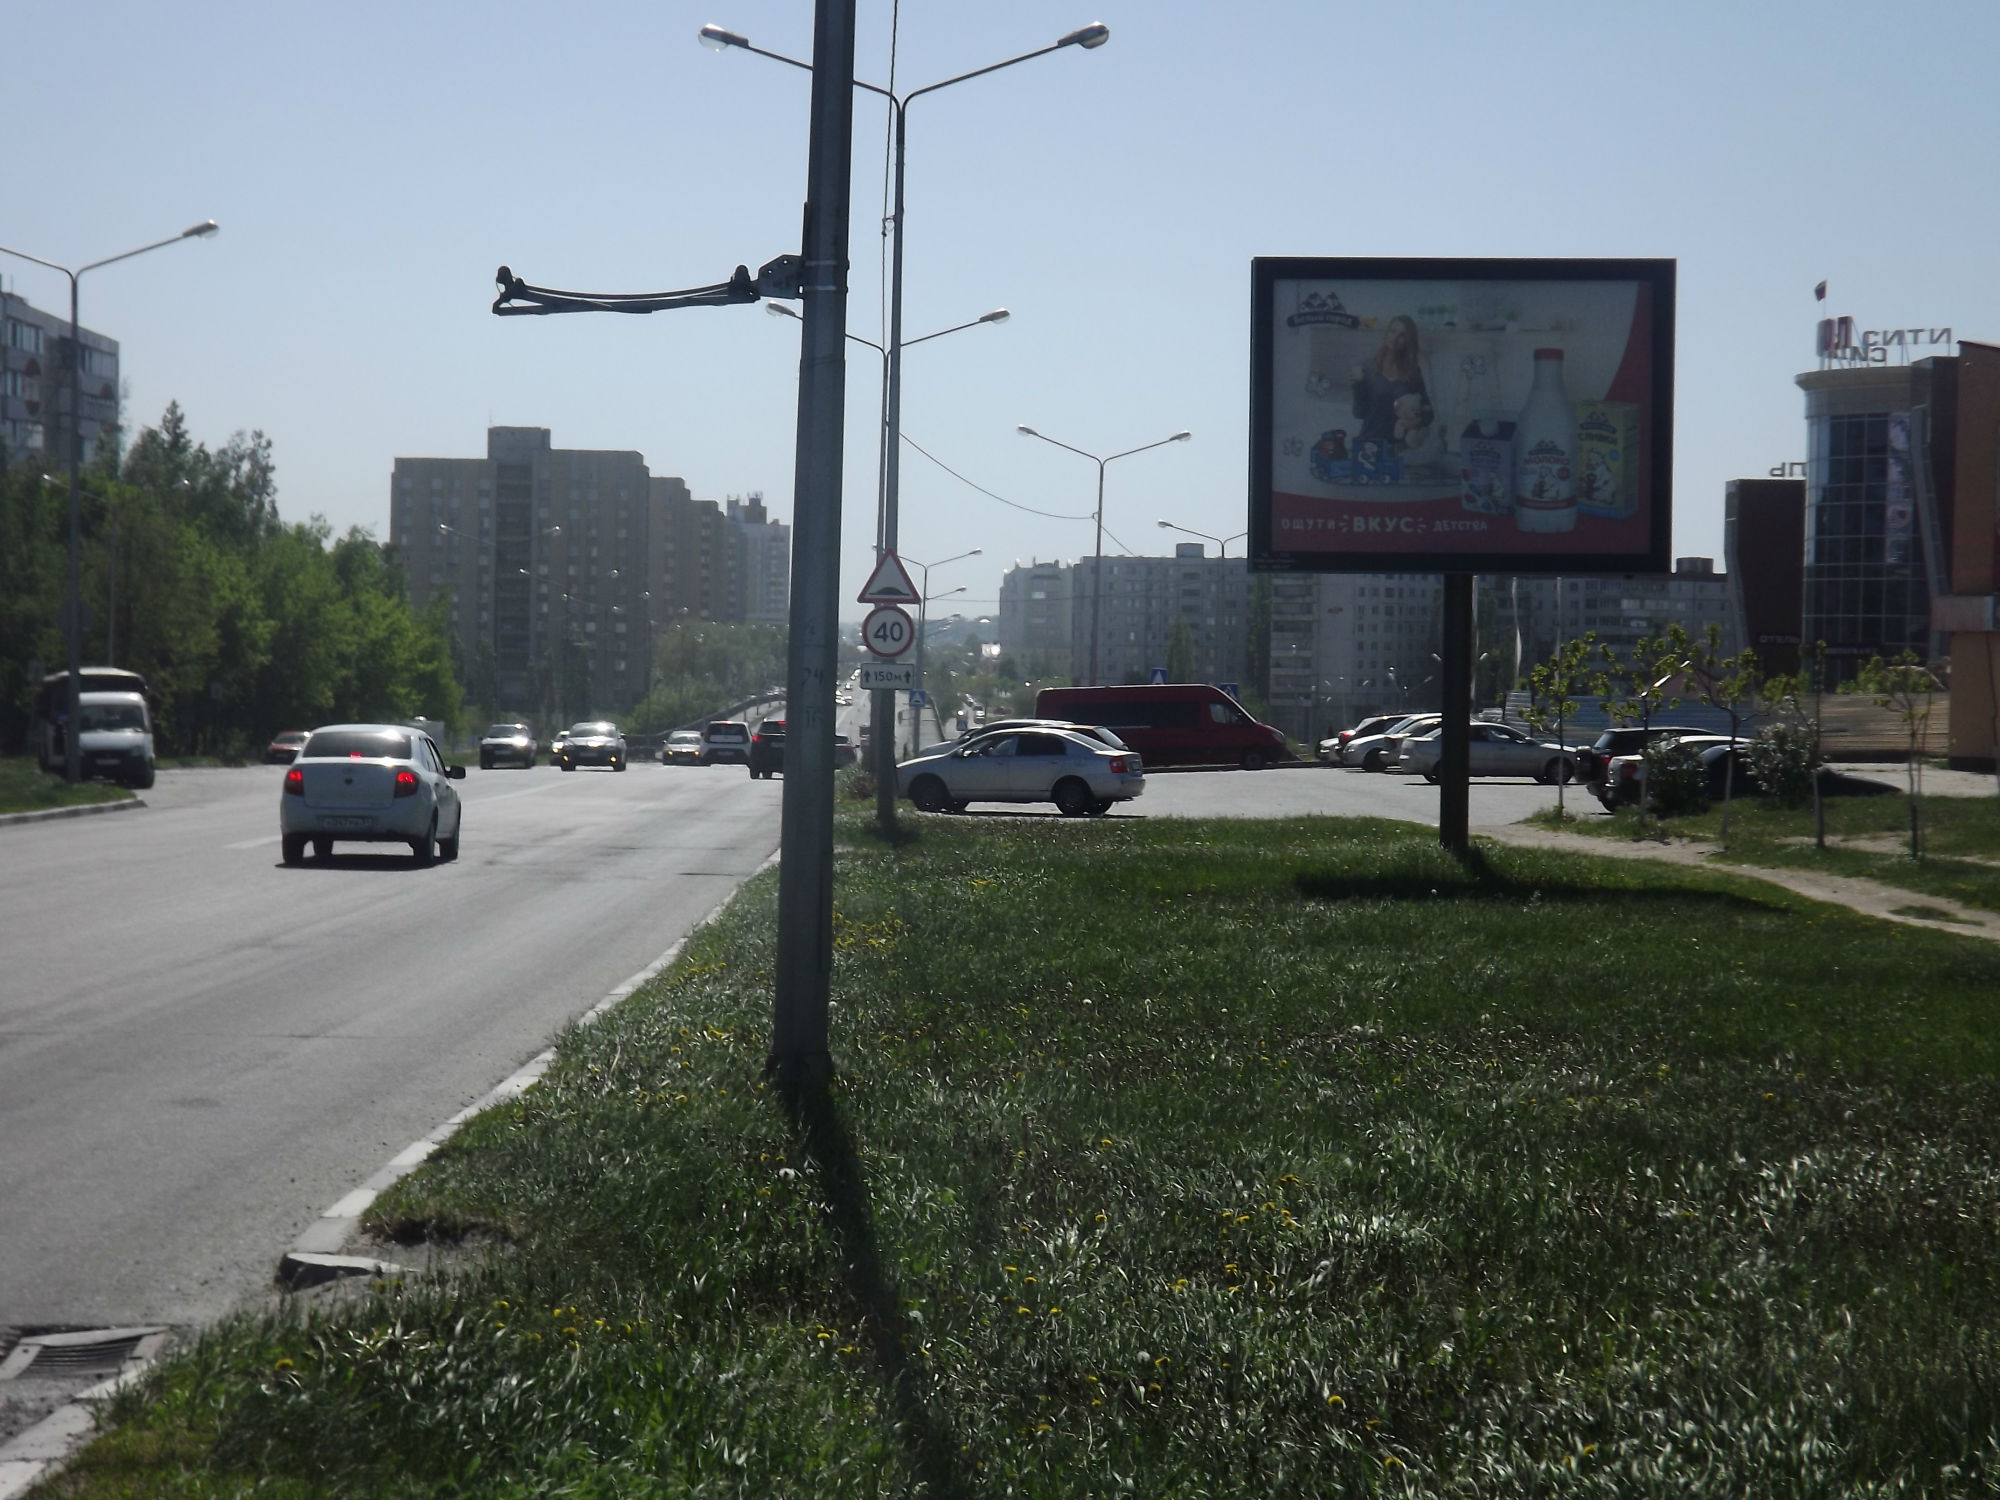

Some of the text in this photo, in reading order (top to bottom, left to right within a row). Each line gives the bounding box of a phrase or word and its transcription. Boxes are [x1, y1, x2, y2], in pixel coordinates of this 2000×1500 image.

[1863, 328, 1951, 346] СИТИ
[1281, 516, 1488, 533] ОЩУТИ ВКУС ДЕТСТВА
[873, 622, 904, 642] 40
